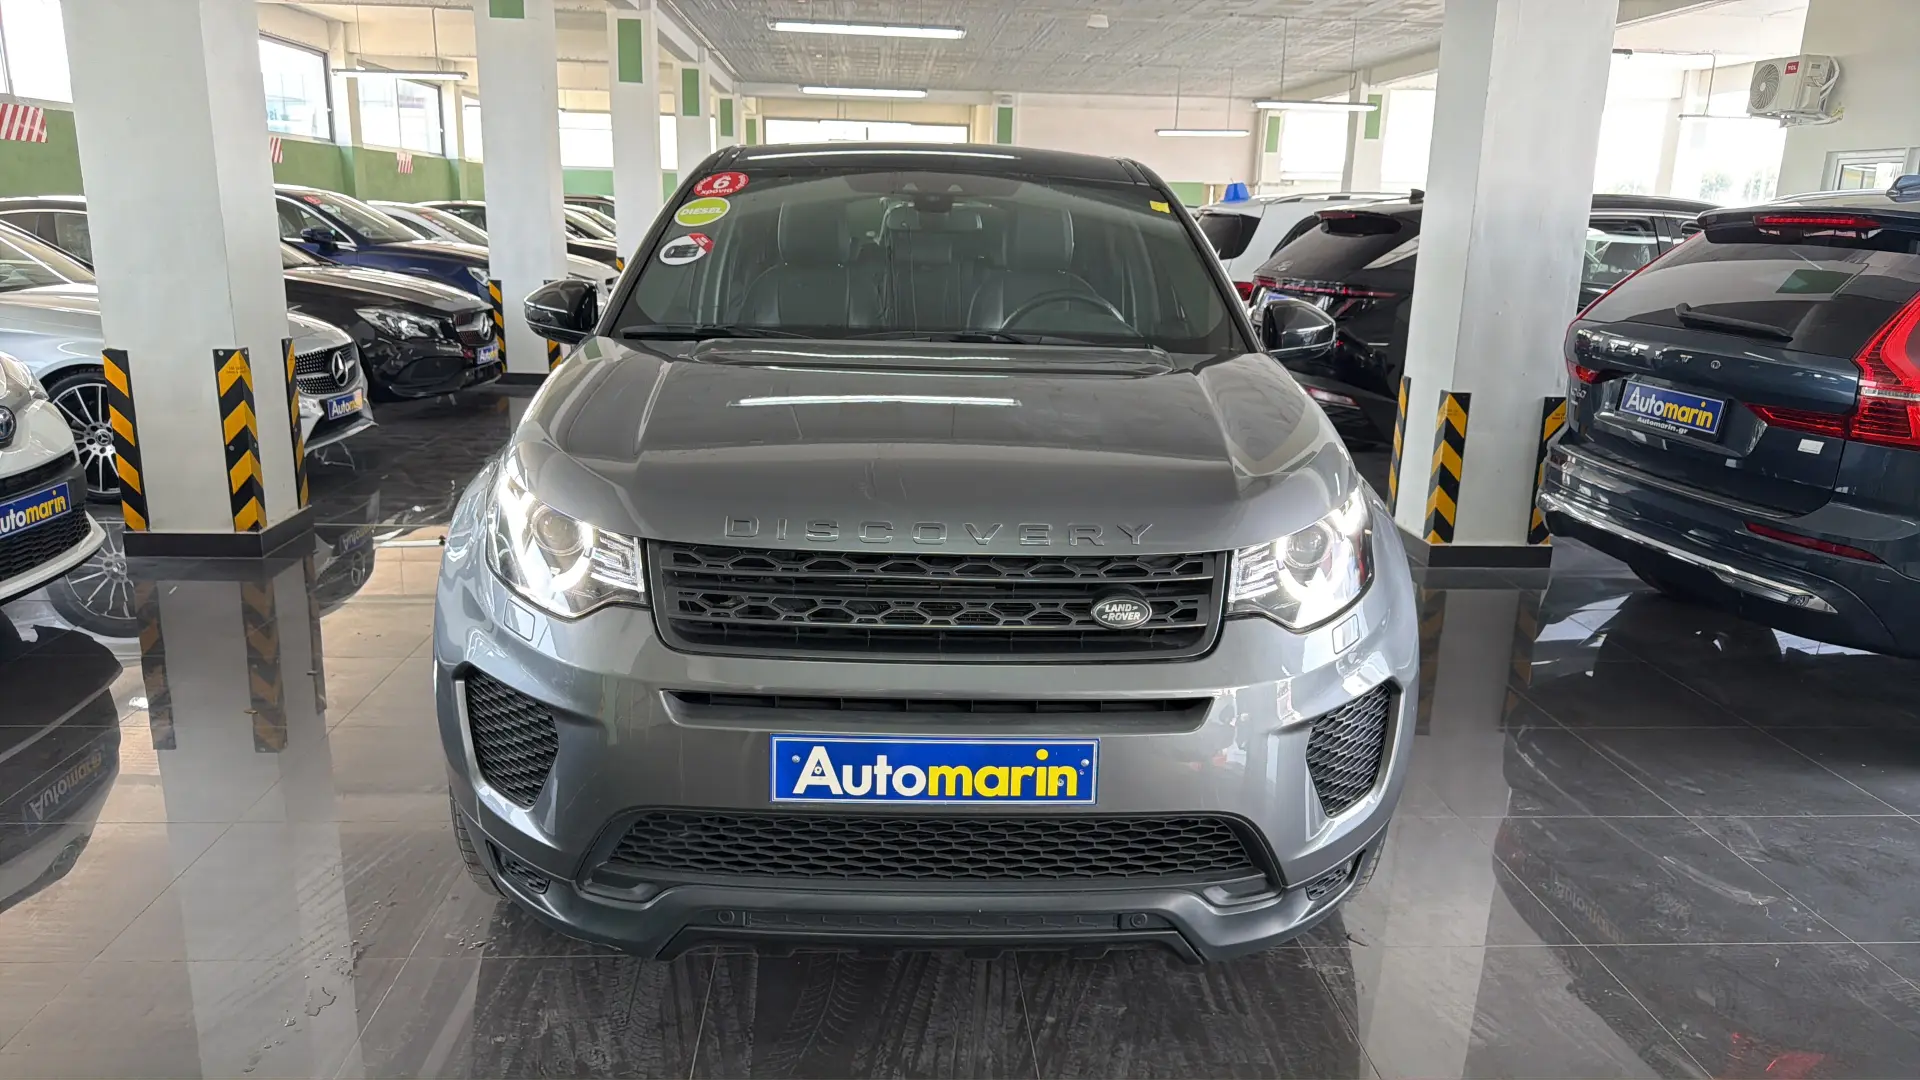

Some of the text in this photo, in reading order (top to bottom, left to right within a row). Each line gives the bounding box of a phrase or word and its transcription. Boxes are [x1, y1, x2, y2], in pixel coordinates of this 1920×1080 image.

[713, 175, 731, 189] 6
[680, 207, 723, 216] DIESEL
[1626, 386, 1713, 428] Automarin
[1637, 416, 1689, 434] Automarin.gr
[0, 490, 67, 535] utomarin
[725, 515, 1153, 546] DISCOVERY
[1105, 604, 1132, 612] LAND
[1108, 612, 1141, 621] ROVER
[793, 746, 1078, 797] Automarin
